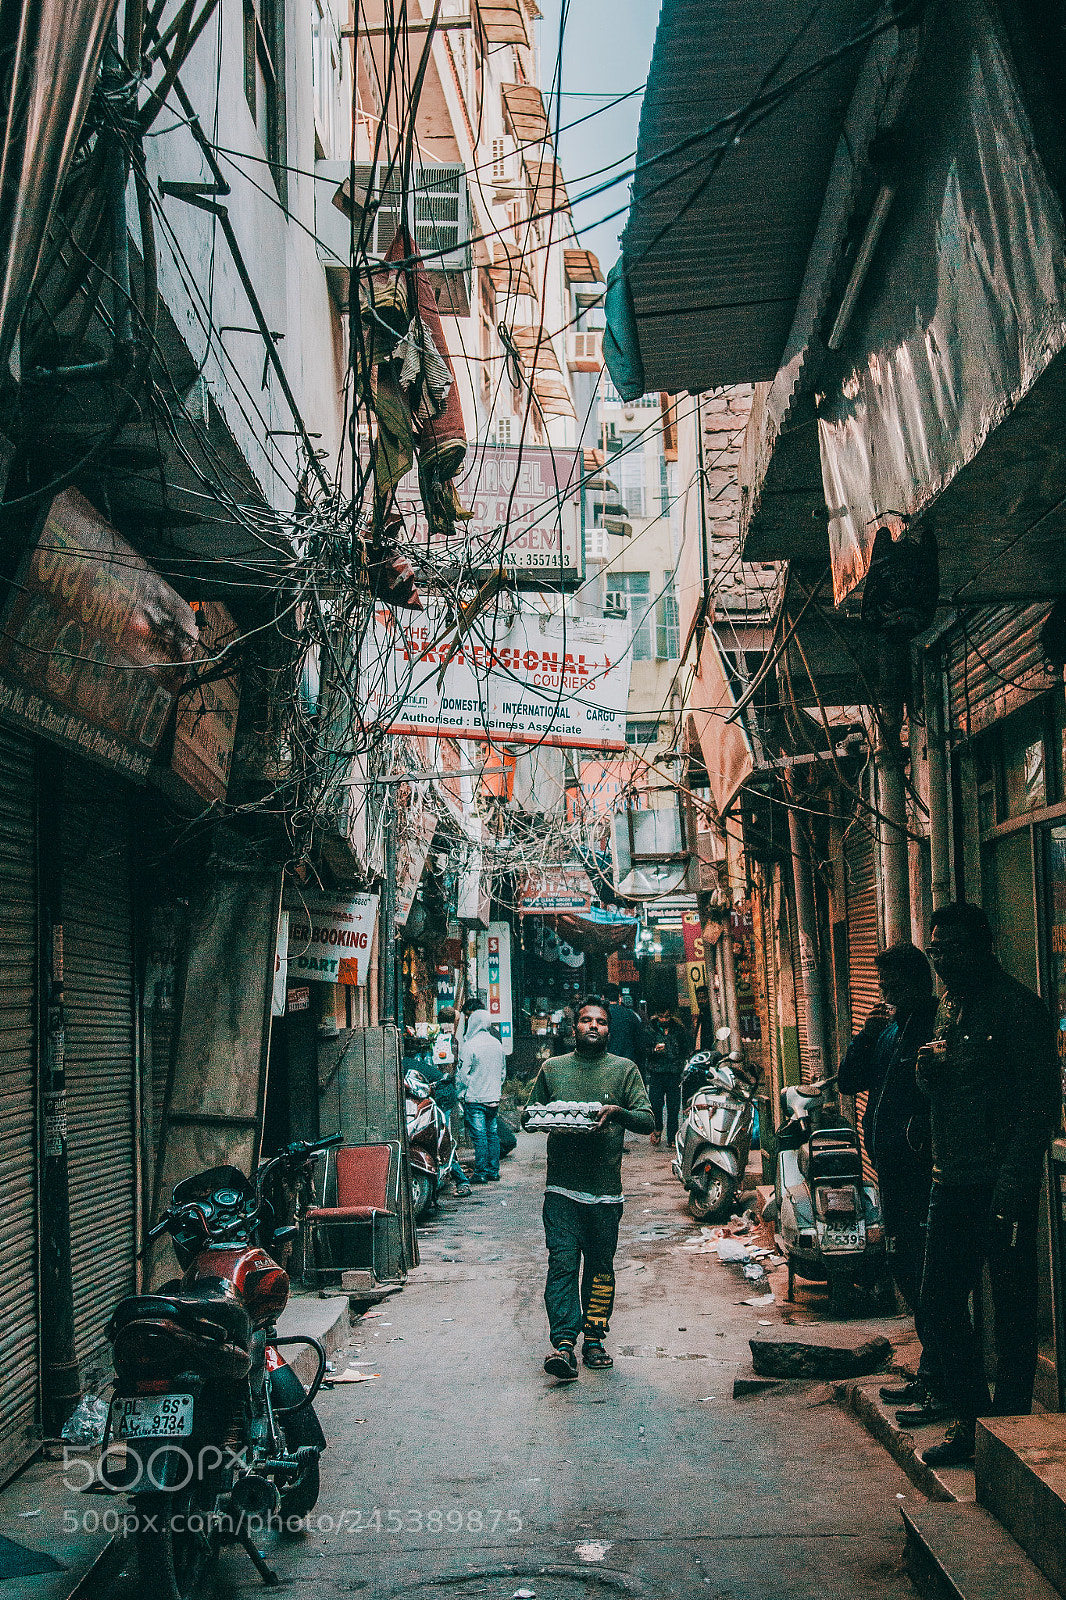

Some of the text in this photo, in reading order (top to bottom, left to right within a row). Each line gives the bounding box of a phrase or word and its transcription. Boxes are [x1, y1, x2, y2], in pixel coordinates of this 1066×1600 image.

[403, 626, 429, 640] THE
[533, 673, 596, 691] COURIERS
[442, 697, 487, 713] DOMESTIC
[502, 702, 571, 719] INTERNATIONAL
[586, 709, 616, 722] CARGO
[401, 712, 463, 726] Authorised
[473, 717, 525, 731] Business
[527, 721, 582, 734] Associate
[312, 927, 368, 949] BOOKING
[297, 956, 338, 973] DART
[151, 1415, 185, 1431] 9734
